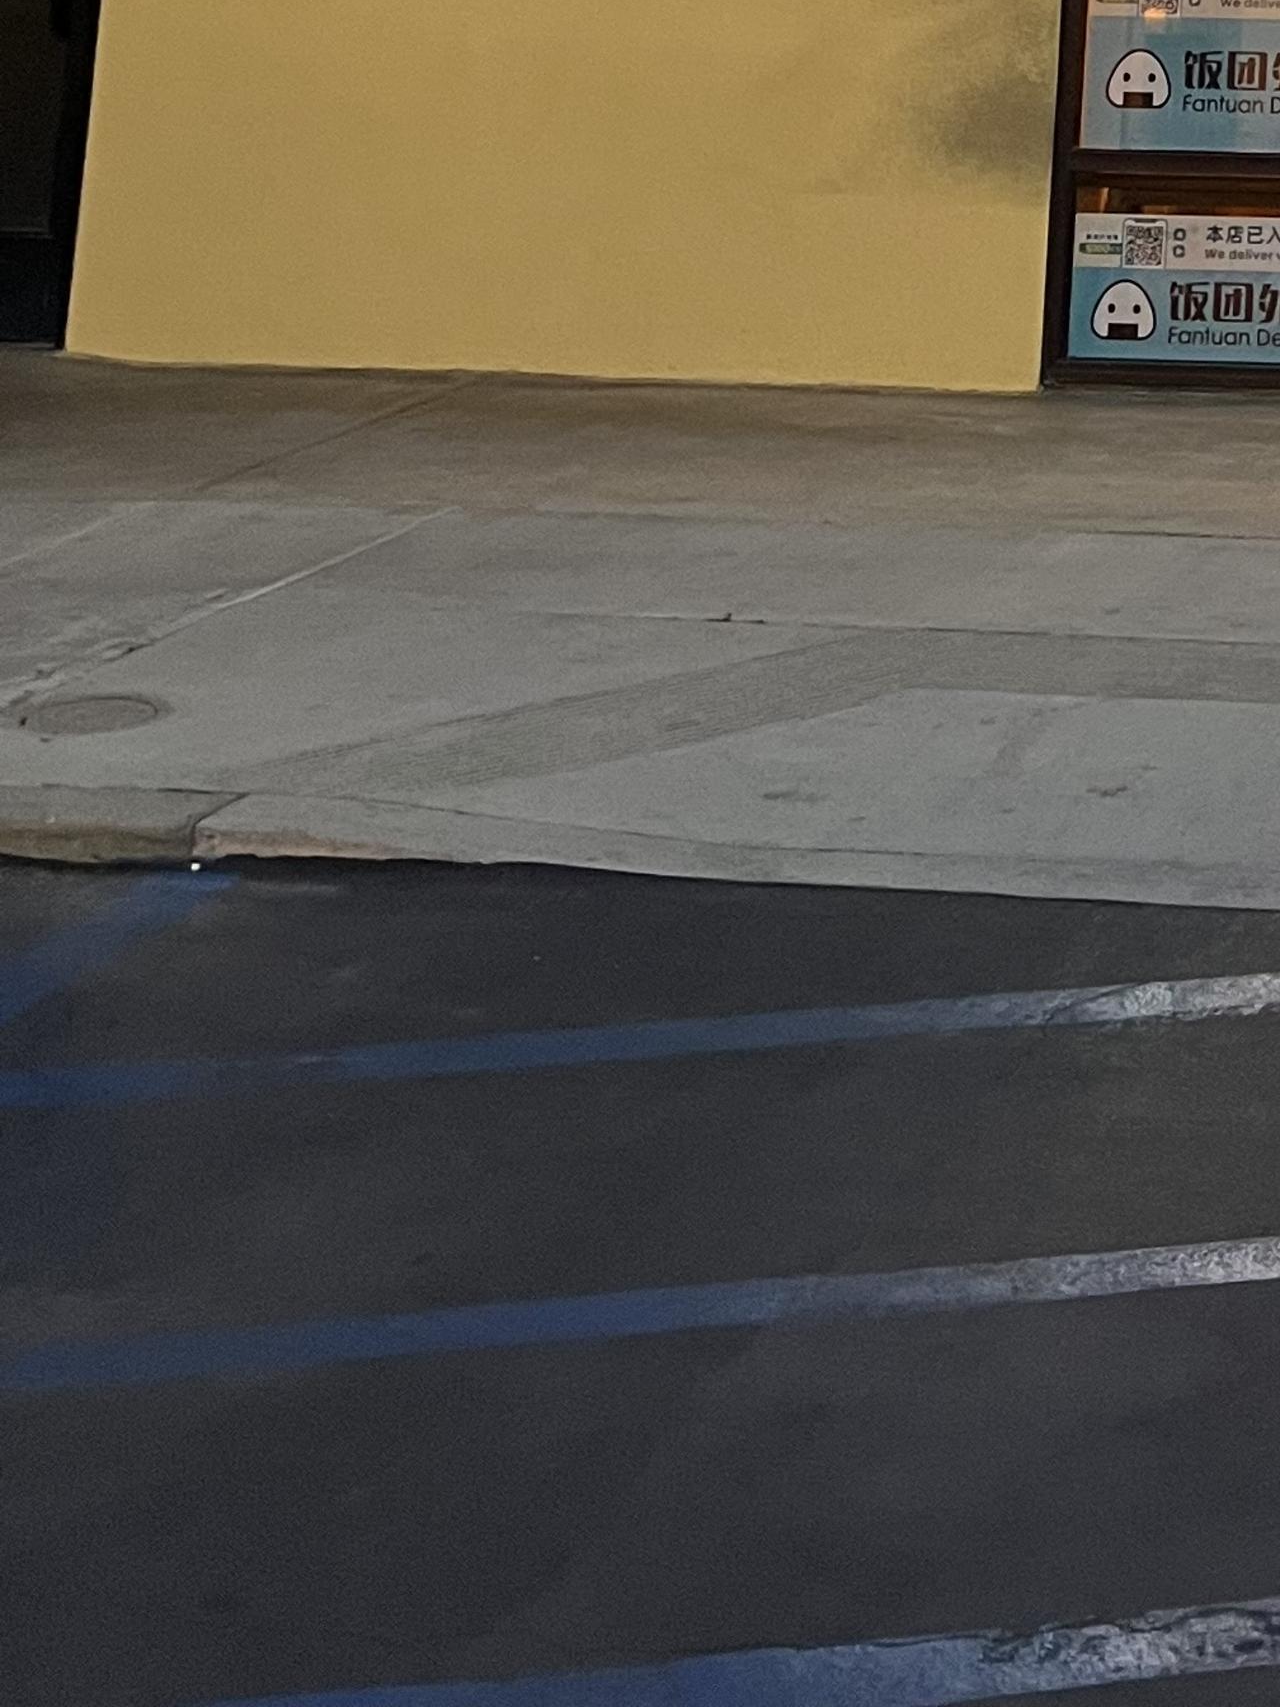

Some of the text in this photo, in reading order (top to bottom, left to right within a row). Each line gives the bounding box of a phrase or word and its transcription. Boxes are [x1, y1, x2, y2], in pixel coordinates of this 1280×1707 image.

[1182, 94, 1264, 114] Fantuan
[1205, 249, 1227, 260] We
[1230, 249, 1275, 261] deliver
[1168, 326, 1250, 347] Fantuan
